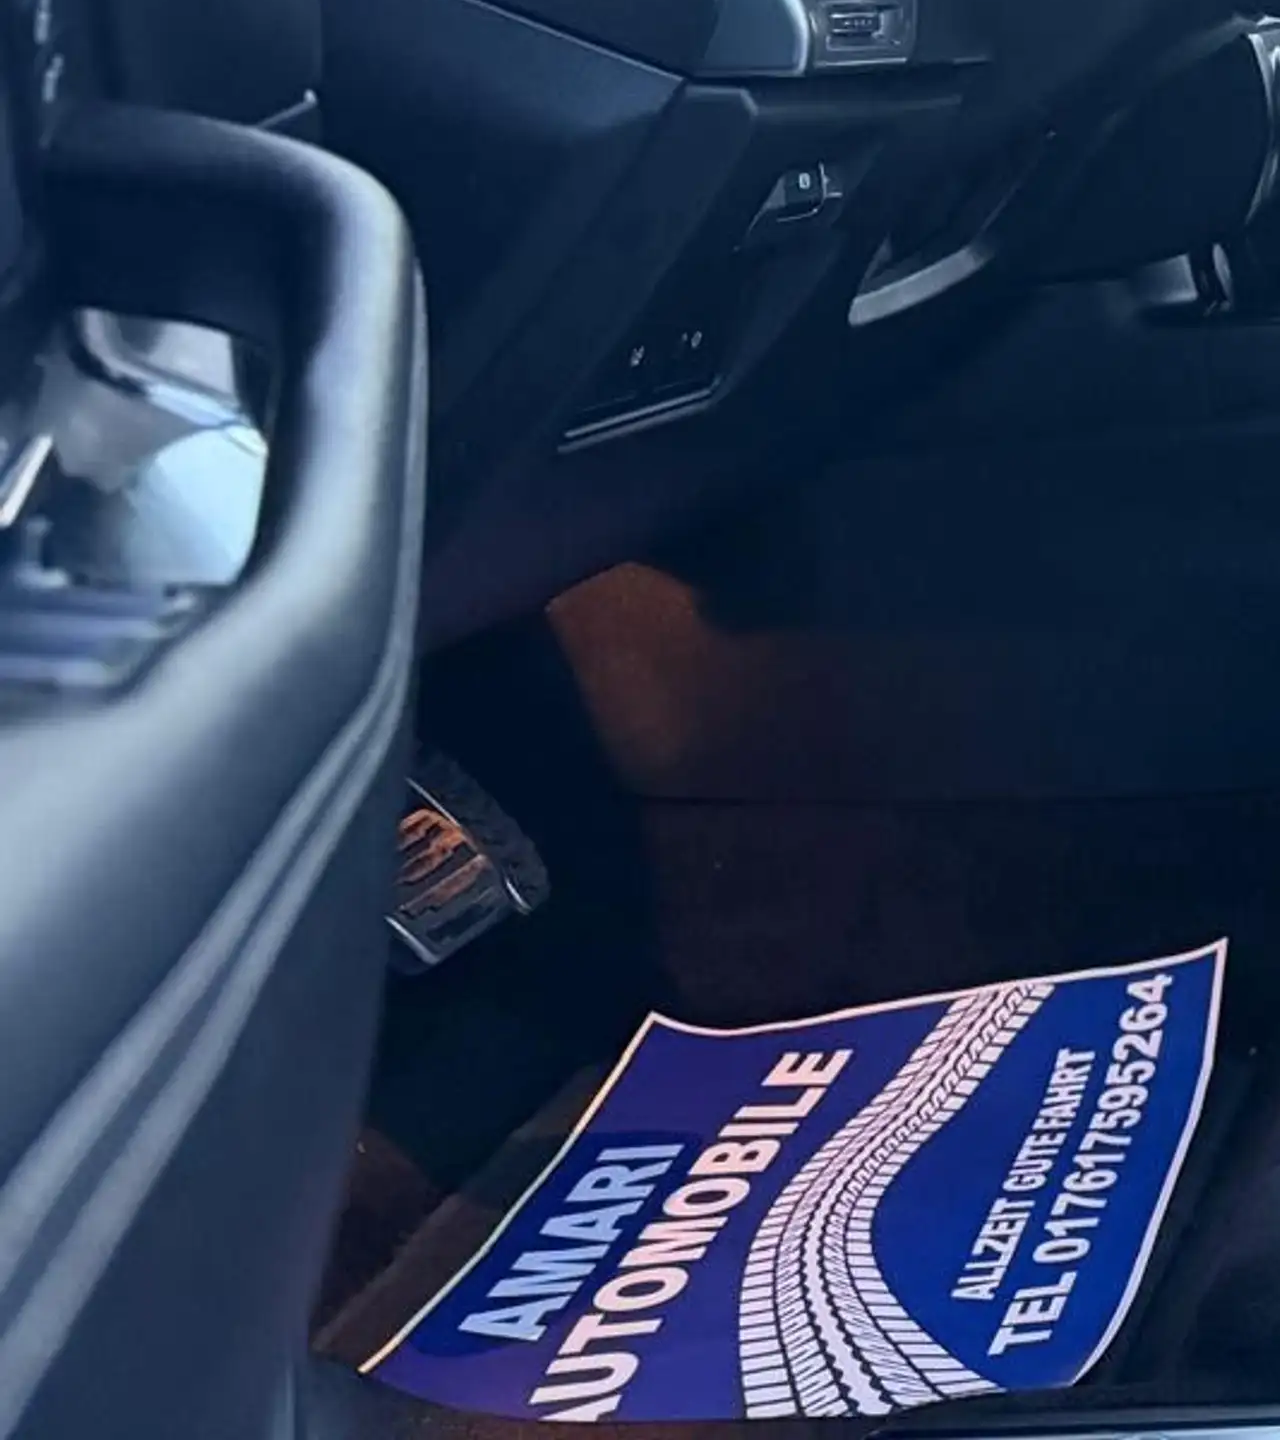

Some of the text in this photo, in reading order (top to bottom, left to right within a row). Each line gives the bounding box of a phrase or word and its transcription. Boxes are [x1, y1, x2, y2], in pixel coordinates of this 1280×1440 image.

[458, 1144, 686, 1342] AMARI
[951, 1047, 1096, 1302] ALLZEIT GUTE FAHRT
[987, 973, 1173, 1357] TEL 017617595264
